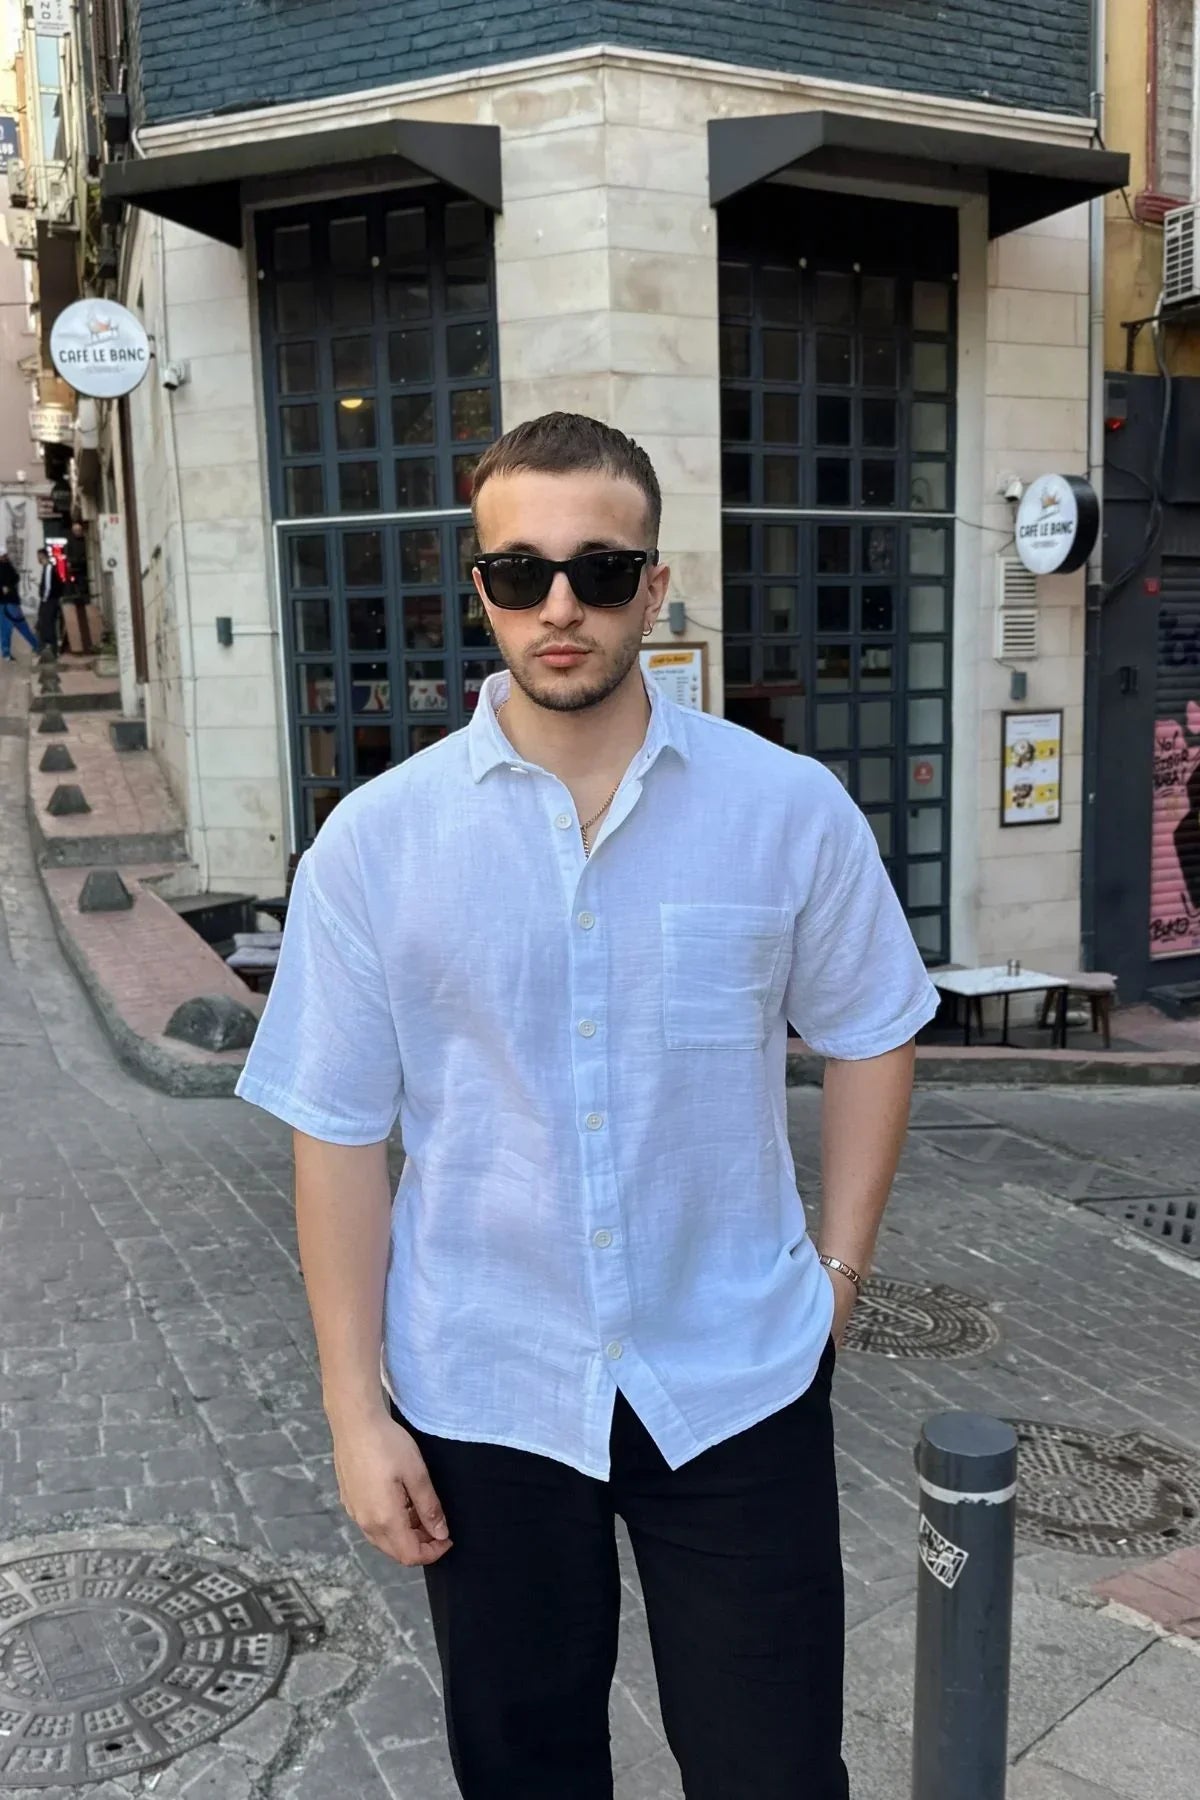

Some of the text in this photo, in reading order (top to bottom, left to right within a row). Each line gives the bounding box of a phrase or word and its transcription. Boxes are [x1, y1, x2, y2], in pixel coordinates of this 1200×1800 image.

[93, 348, 106, 362] LE
[110, 347, 145, 361] BANC
[1040, 522, 1048, 536] LE
[1051, 520, 1073, 535] BANC
